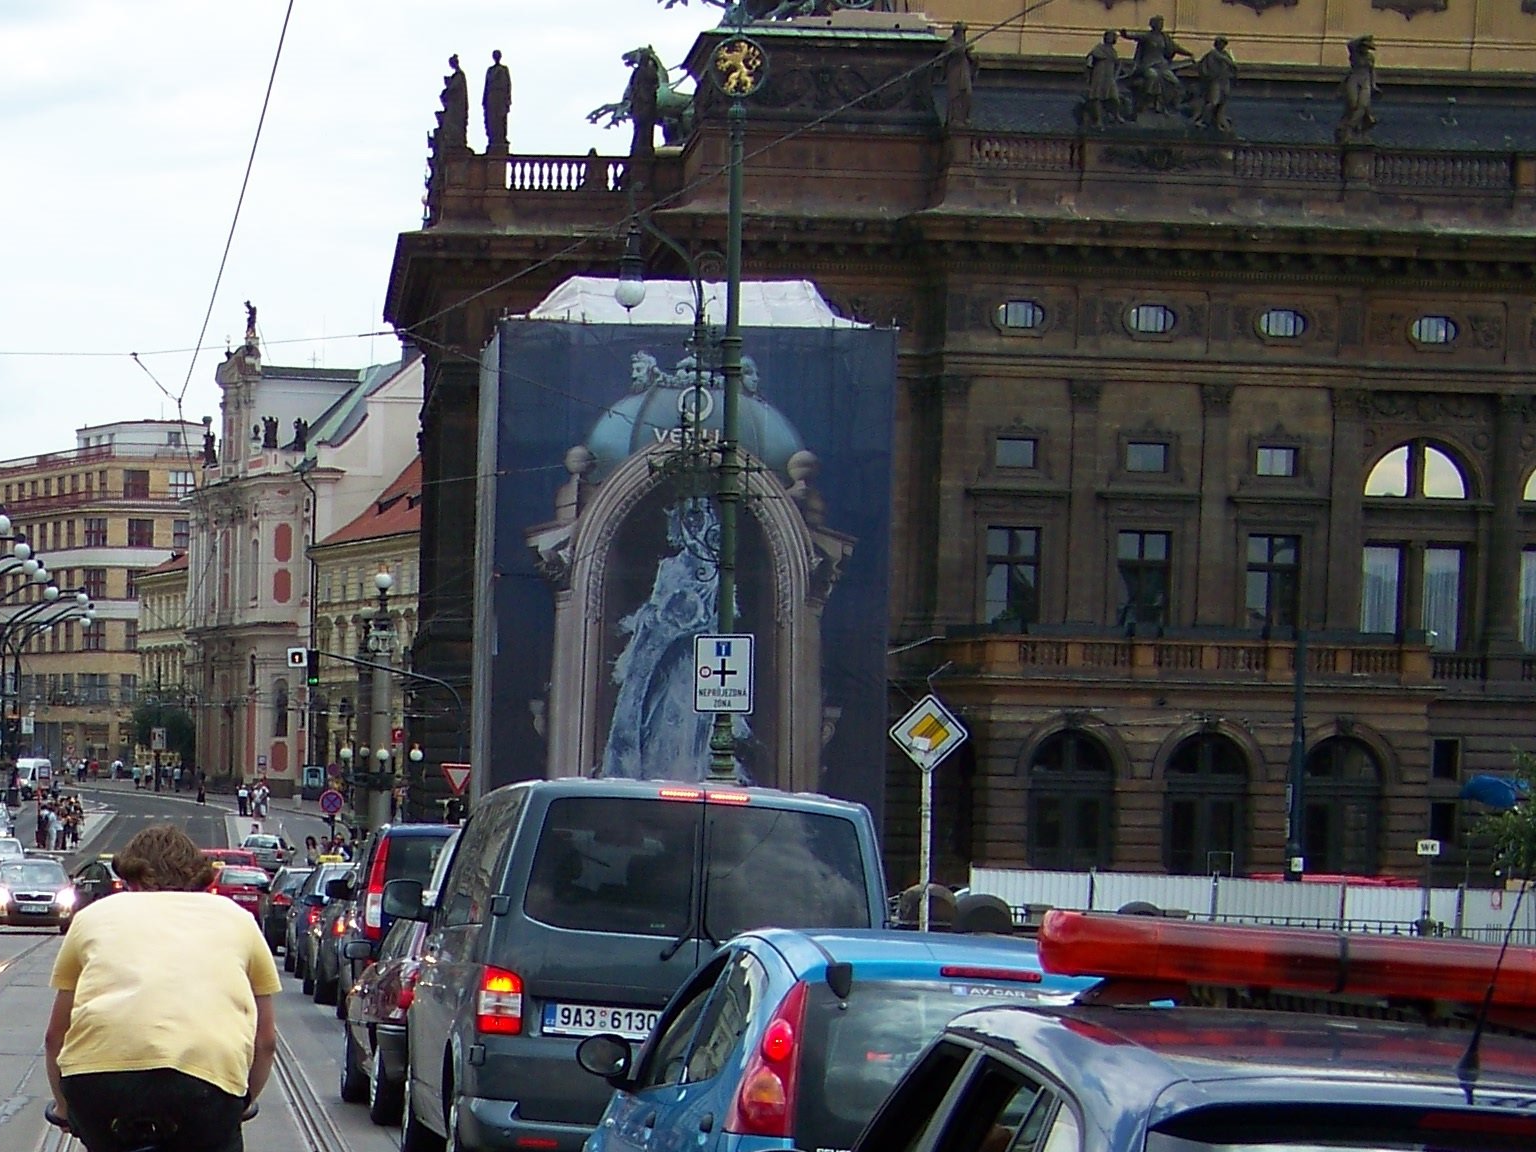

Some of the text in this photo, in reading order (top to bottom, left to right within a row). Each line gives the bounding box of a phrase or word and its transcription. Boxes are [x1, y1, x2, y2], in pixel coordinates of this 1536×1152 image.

[1420, 842, 1438, 852] WC
[560, 1007, 658, 1032] 9A3 6130
